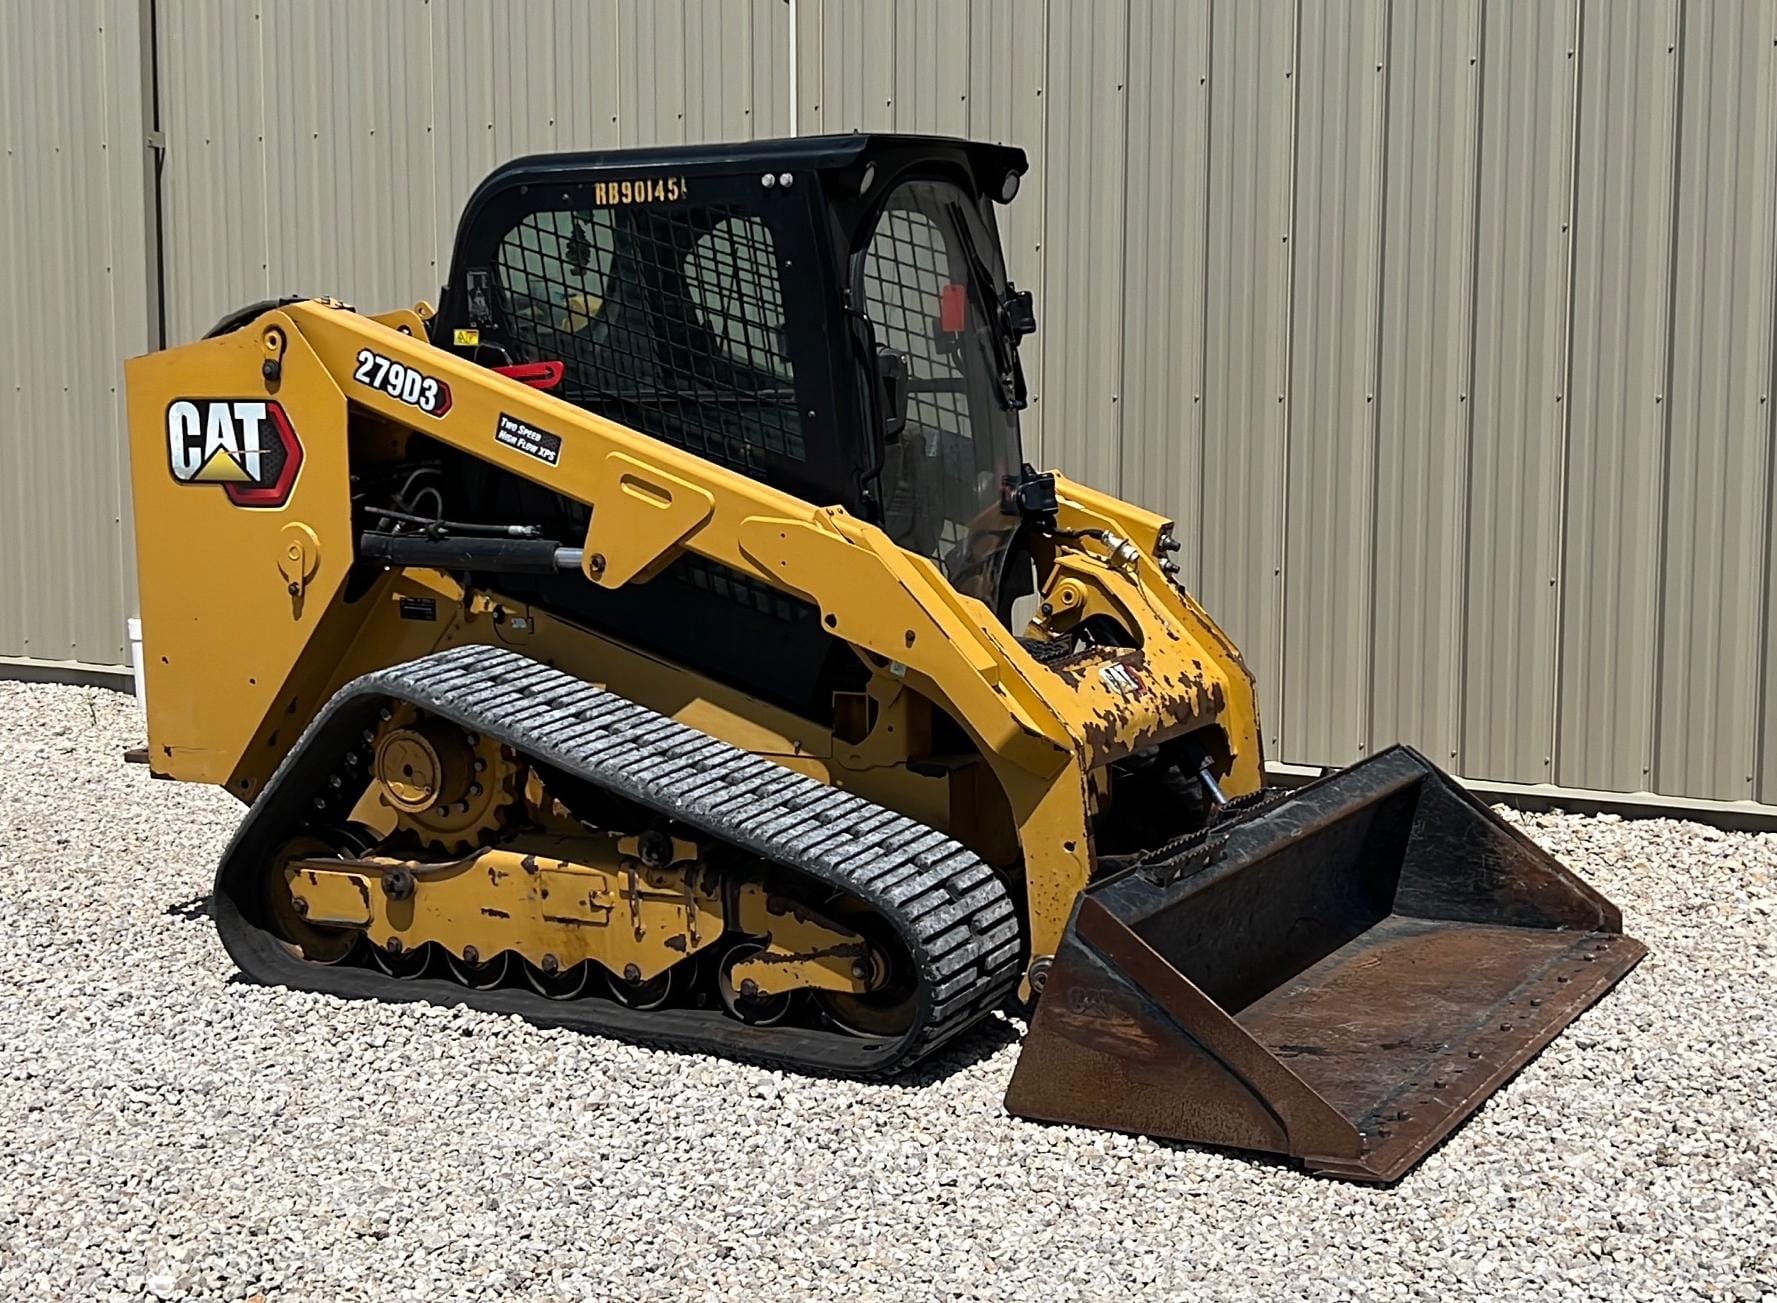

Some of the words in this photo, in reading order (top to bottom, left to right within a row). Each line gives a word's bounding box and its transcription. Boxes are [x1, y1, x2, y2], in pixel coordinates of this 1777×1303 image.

[354, 349, 440, 413] 279D3
[167, 401, 268, 482] CAT
[538, 447, 557, 461] XPS
